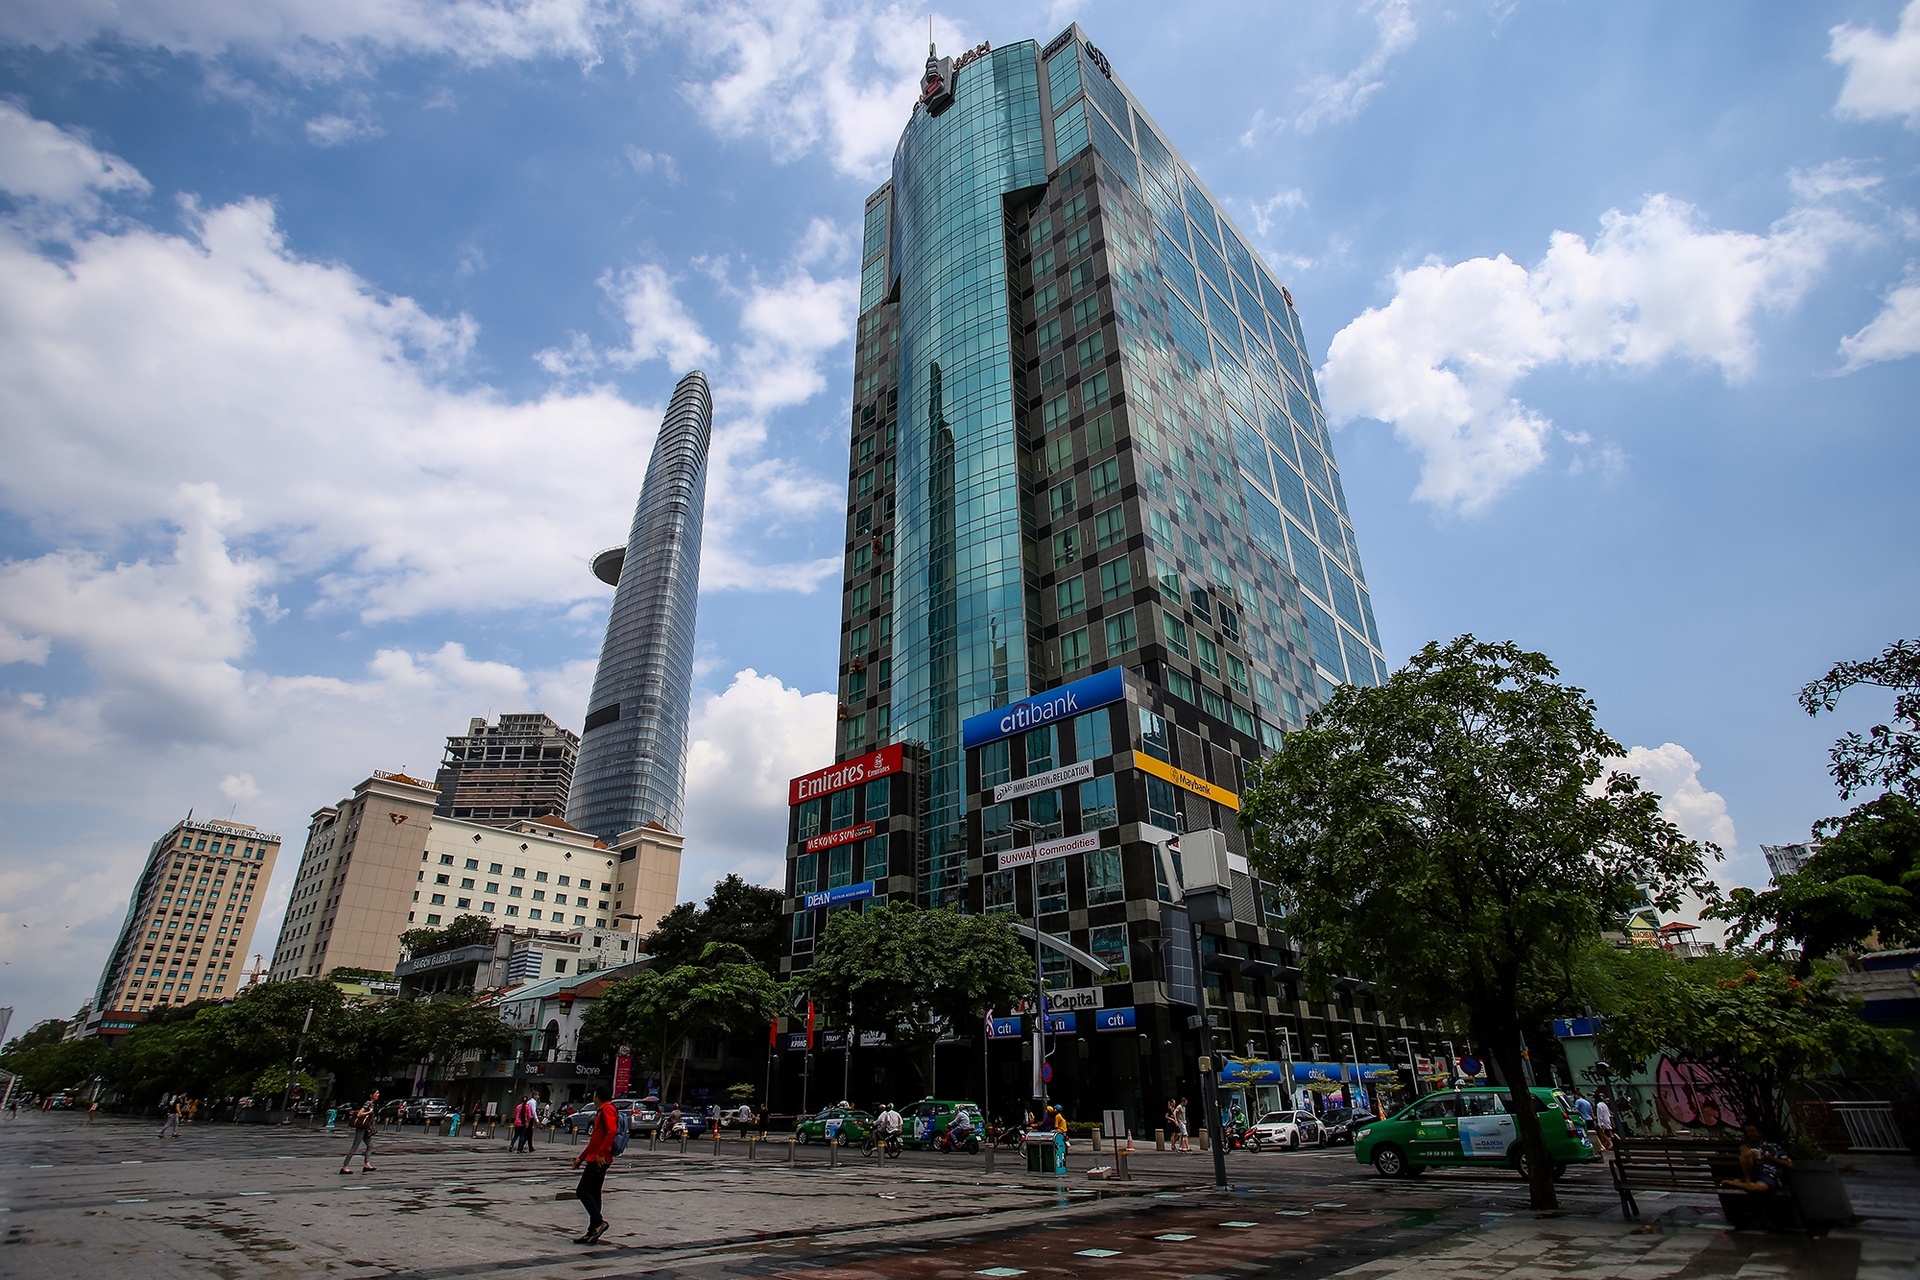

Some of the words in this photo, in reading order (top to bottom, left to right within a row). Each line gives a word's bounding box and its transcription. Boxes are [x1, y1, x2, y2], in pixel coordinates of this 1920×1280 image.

[1000, 690, 1078, 733] citibank
[798, 763, 864, 799] Emirates
[867, 765, 890, 779] Emirates
[1013, 776, 1051, 793] IMMIGRATION
[1053, 764, 1090, 783] RELOCATION
[1179, 773, 1212, 796] Maybank
[194, 822, 233, 835] HARBOUR
[234, 828, 254, 837] VIEW
[255, 832, 282, 842] TOWER
[807, 834, 838, 850] MEKONG
[839, 829, 855, 842] SUN
[1039, 838, 1096, 857] Commodities
[807, 892, 831, 908] DEAN
[413, 958, 431, 970] SAIGON
[431, 952, 452, 967] GARDEN
[997, 1023, 1012, 1035] citi
[1050, 1019, 1066, 1031] iti
[1107, 1014, 1124, 1027] citi
[575, 1064, 601, 1075] Share
